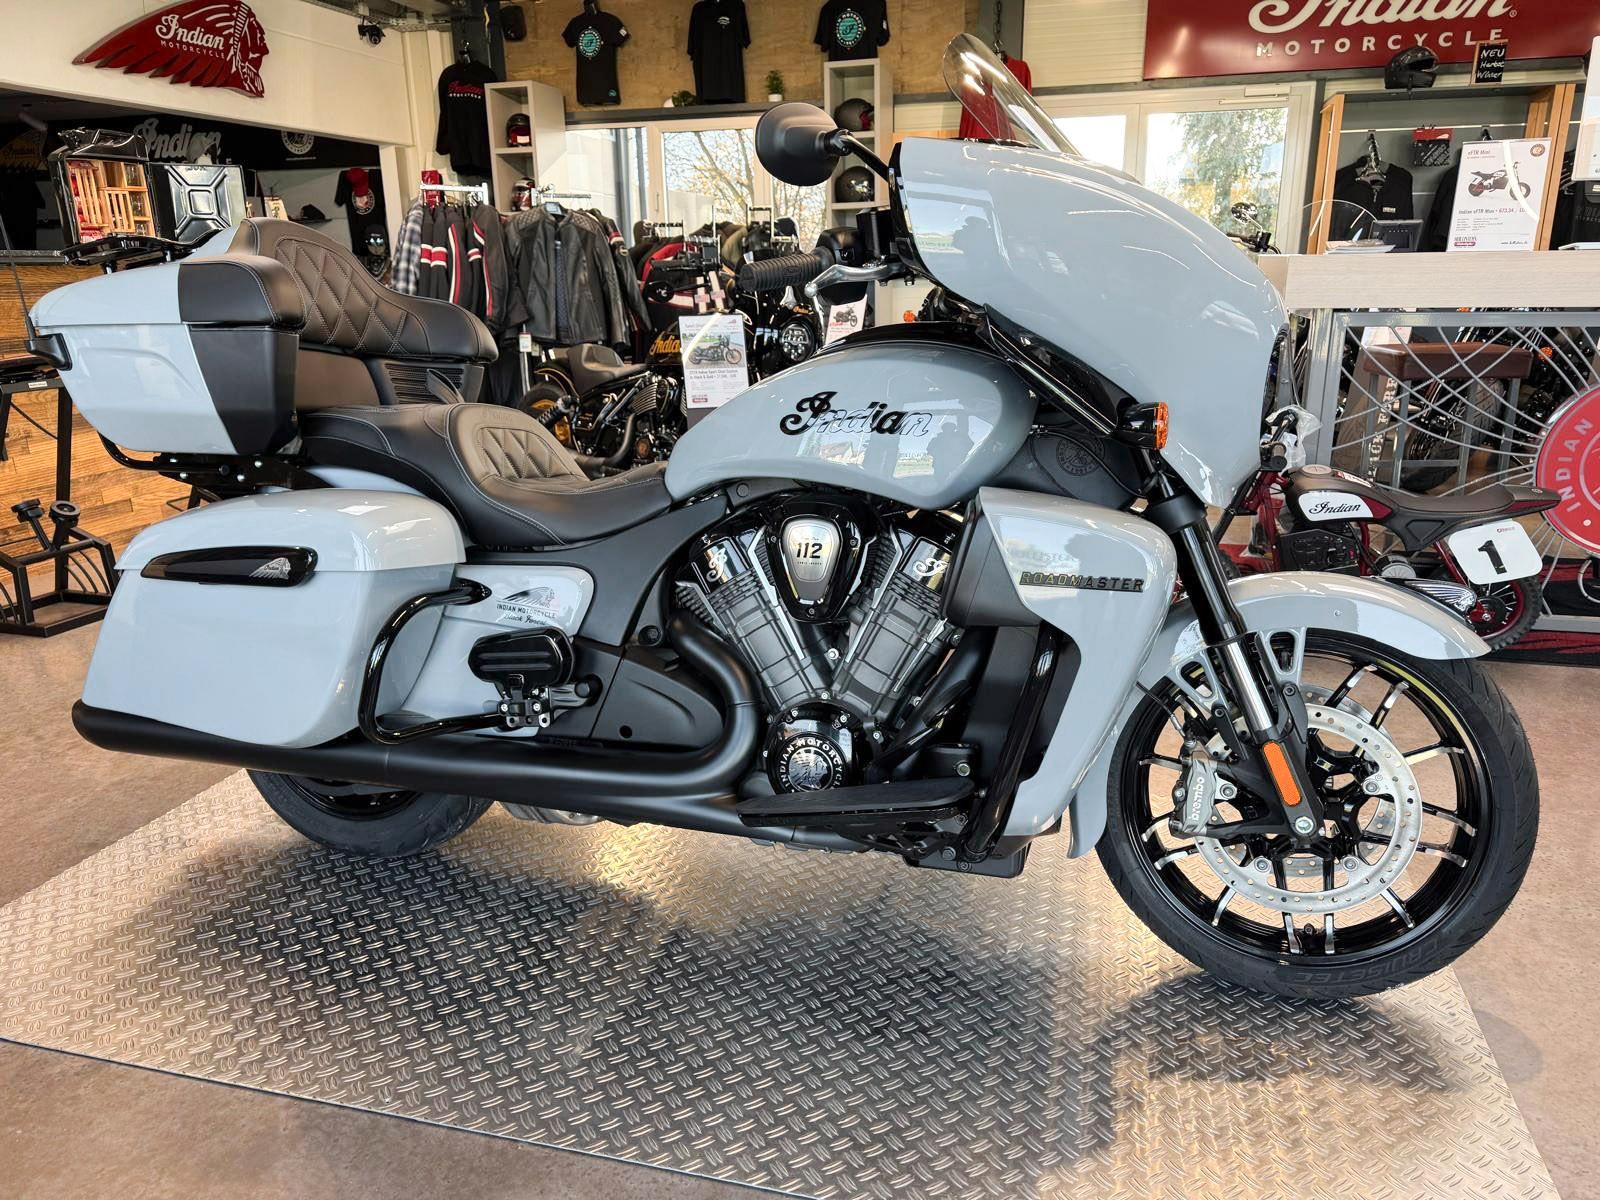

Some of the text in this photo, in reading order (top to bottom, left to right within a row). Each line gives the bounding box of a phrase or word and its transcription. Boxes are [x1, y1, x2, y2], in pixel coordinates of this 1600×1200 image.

[155, 14, 225, 50] Indian
[1256, 29, 1503, 57] MOTORCYCLE
[160, 39, 225, 59] MOTORCYCLE
[1480, 48, 1505, 59] NEU
[779, 391, 933, 437] Indian
[1555, 417, 1594, 513] INDIAN
[1308, 501, 1361, 515] Indian
[796, 542, 822, 559] 112
[1477, 539, 1508, 575] 1
[1019, 571, 1145, 593] ROADMASTER
[496, 603, 556, 619] INDIAN MOTORCYCLE
[780, 737, 843, 788] INDIAN MOTORCYCL
[1188, 776, 1205, 821] brembo
